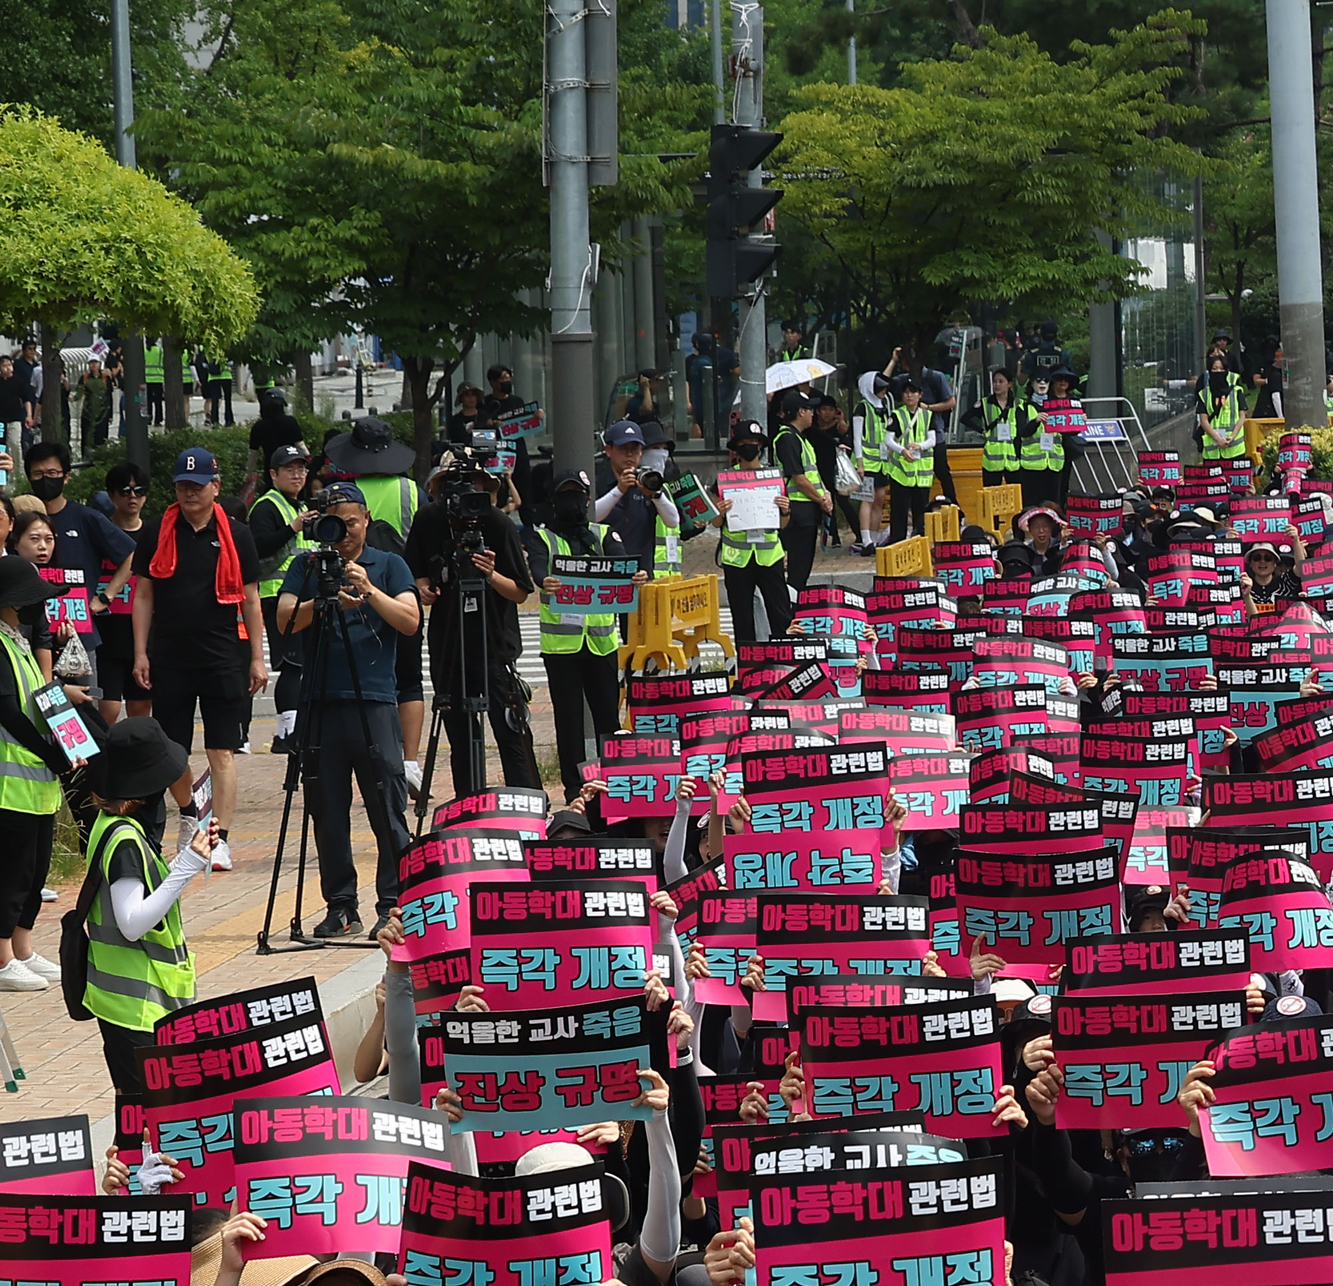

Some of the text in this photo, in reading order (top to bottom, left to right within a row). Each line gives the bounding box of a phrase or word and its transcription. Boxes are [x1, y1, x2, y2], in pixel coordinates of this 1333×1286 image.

[1084, 425, 1104, 436] LINE
[186, 456, 196, 471] B
[1231, 499, 1289, 511] 아동학대 관련법
[1234, 518, 1288, 533] 즉각 개정
[1114, 635, 1208, 653] 억울한 교사 죽음
[733, 848, 874, 890] 즉각 개정
[446, 1006, 642, 1044] 억울한 교사 죽음
[454, 1059, 642, 1112] 진상 규명
[410, 1177, 602, 1225] 아동학대 관련법
